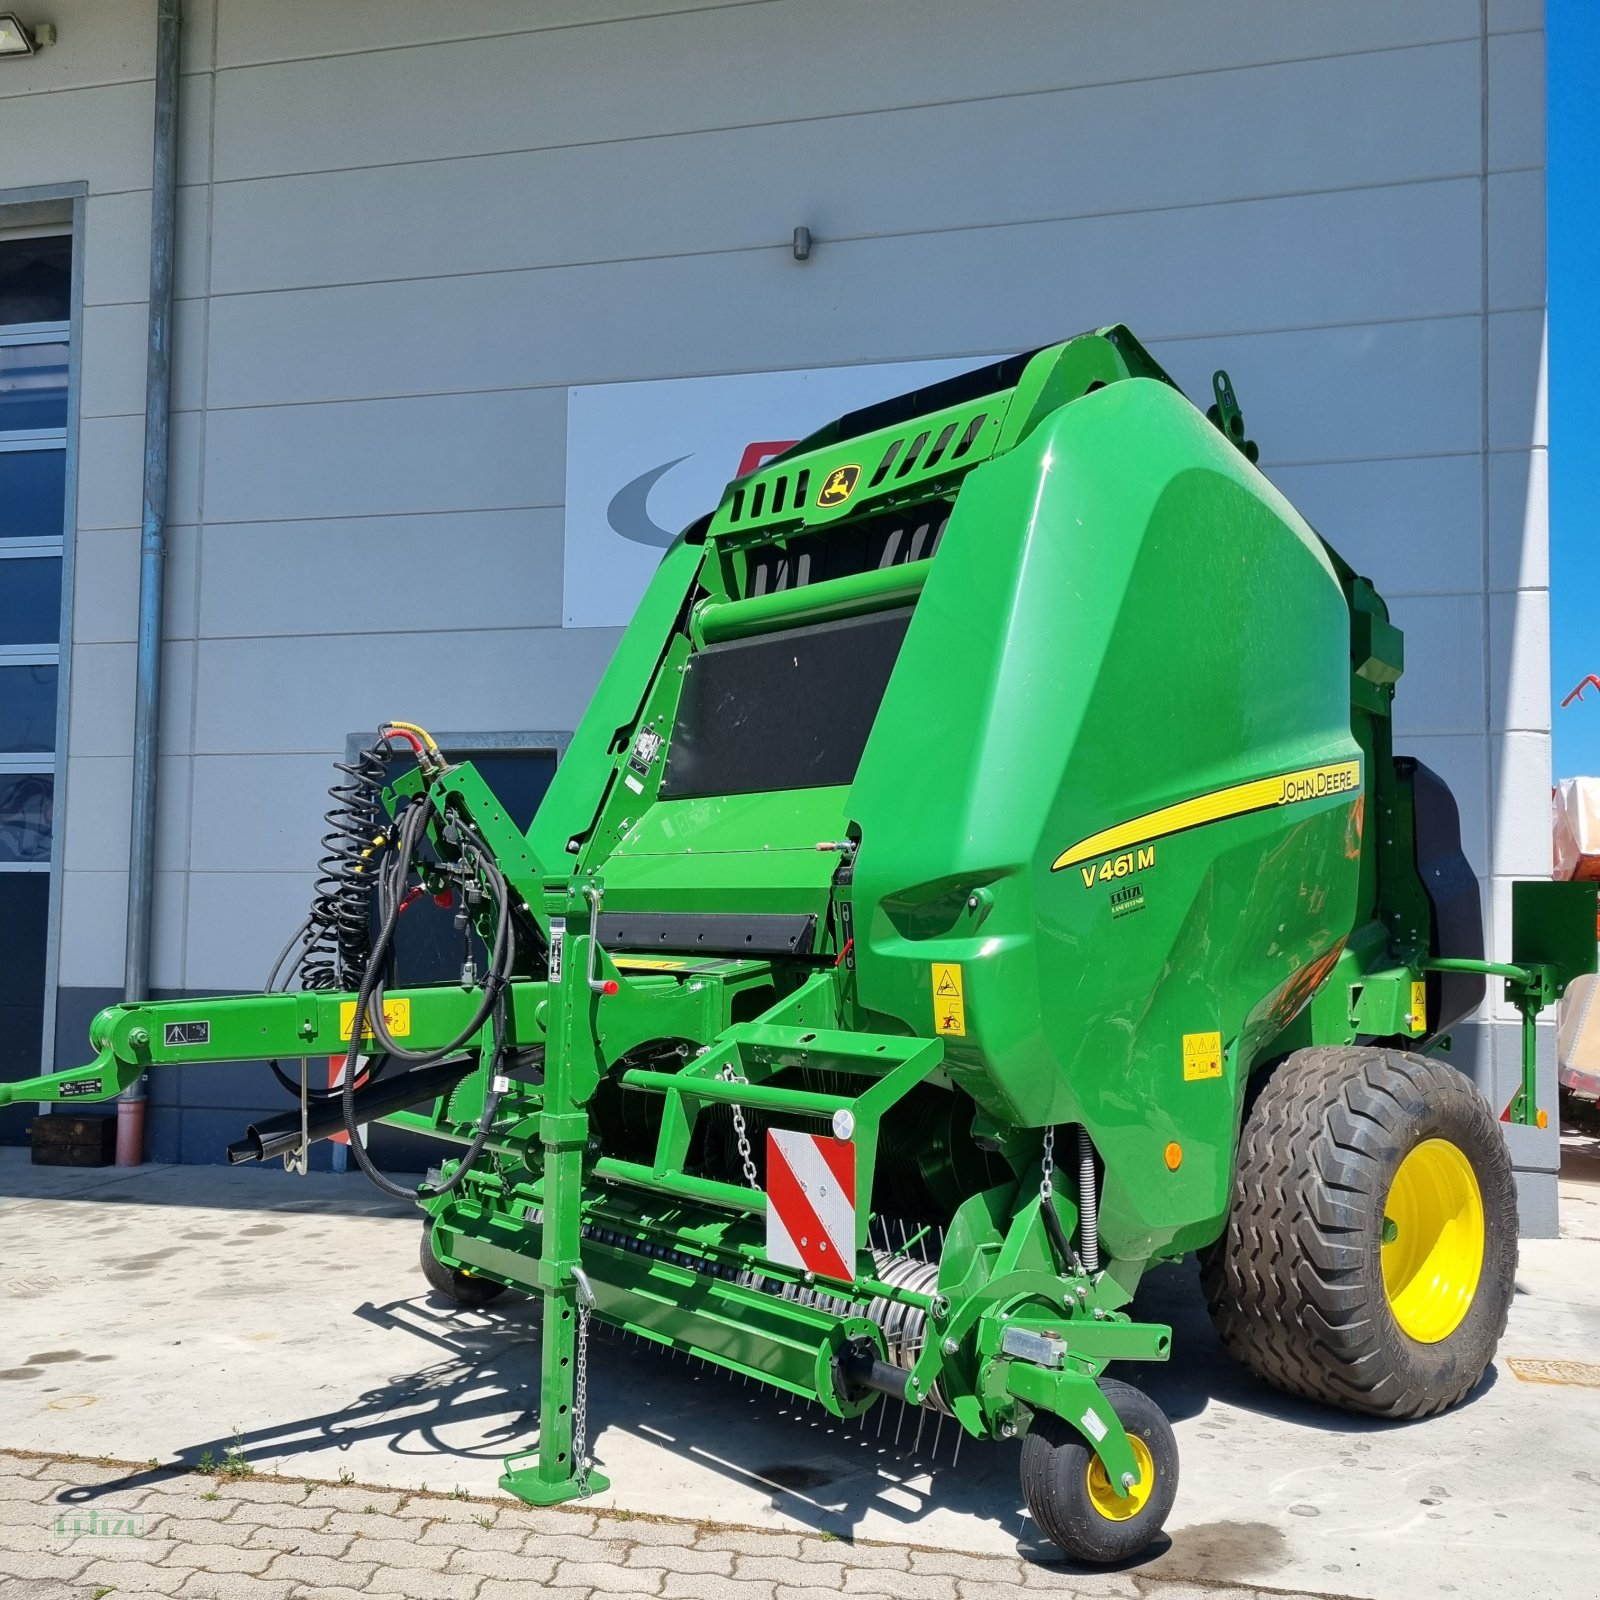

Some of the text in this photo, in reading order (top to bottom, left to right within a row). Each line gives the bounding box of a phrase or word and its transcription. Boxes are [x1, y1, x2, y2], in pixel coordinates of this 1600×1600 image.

[1278, 770, 1353, 801] JOHN DEERE
[1081, 844, 1155, 889] V 461 M
